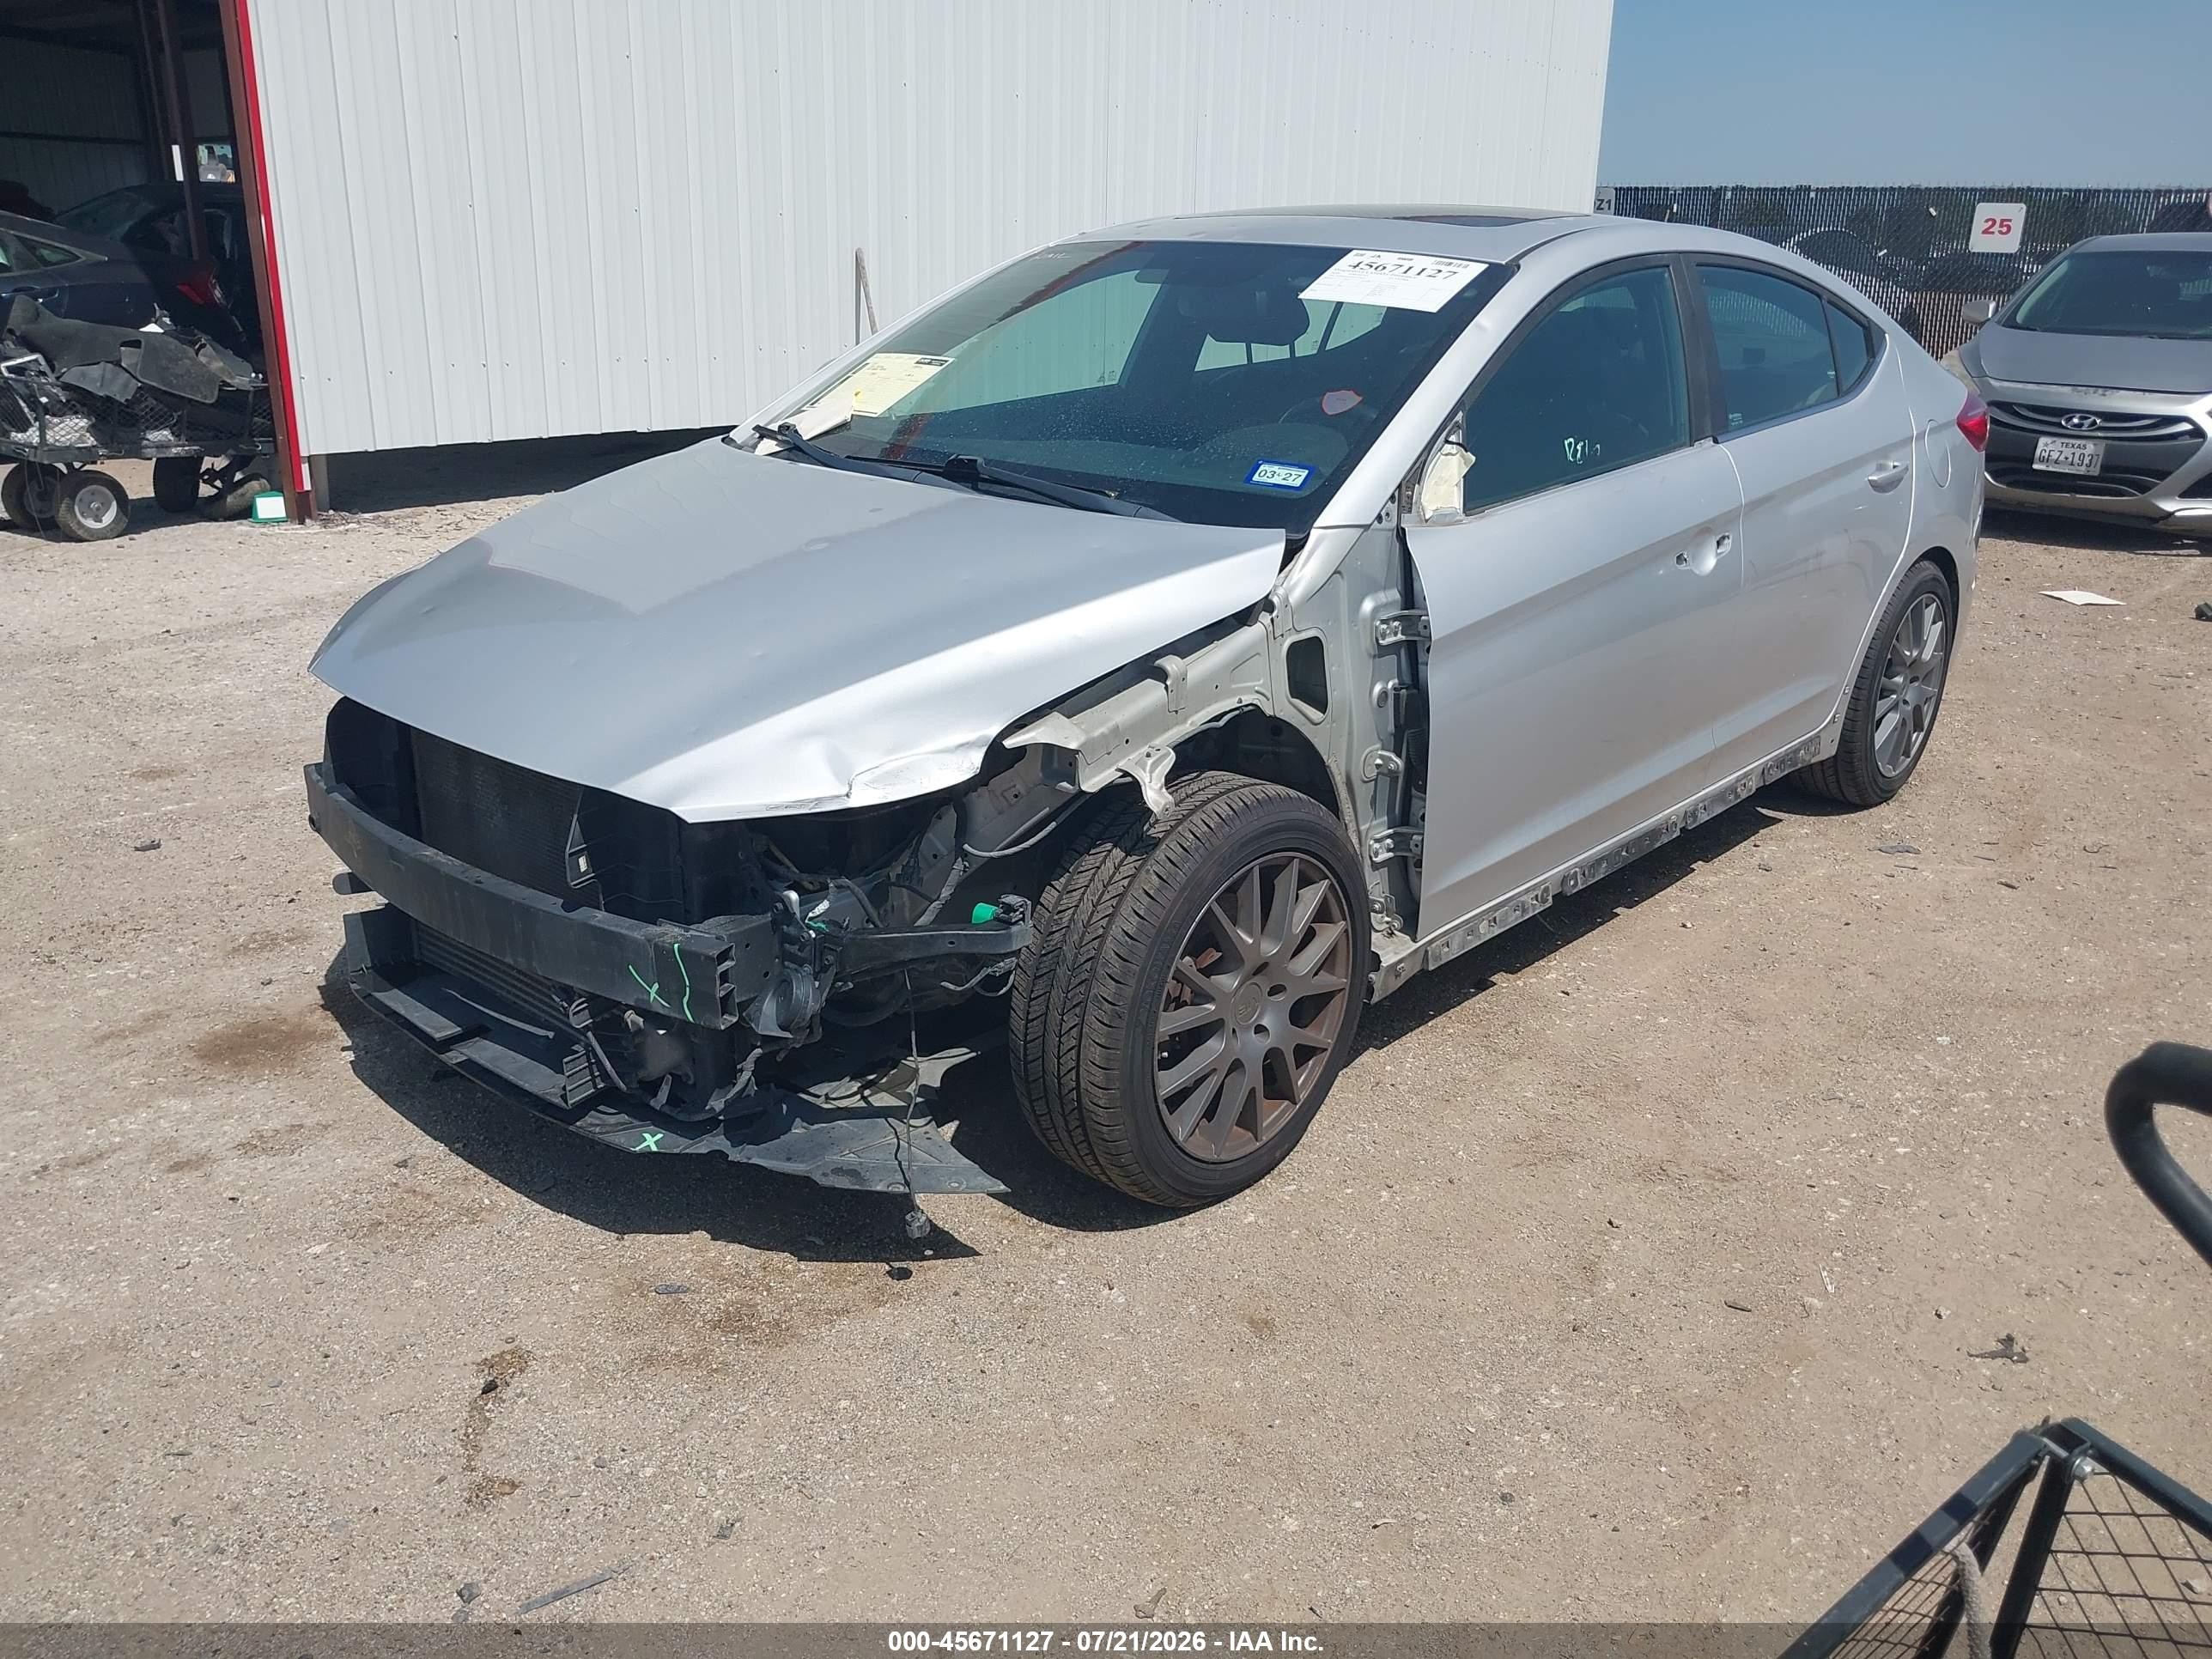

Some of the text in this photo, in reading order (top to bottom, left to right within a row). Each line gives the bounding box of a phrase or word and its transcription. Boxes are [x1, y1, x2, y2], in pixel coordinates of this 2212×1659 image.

[1981, 217, 2014, 236] 25
[1348, 260, 1459, 280] 45671127
[2060, 441, 2087, 451] TEXAS
